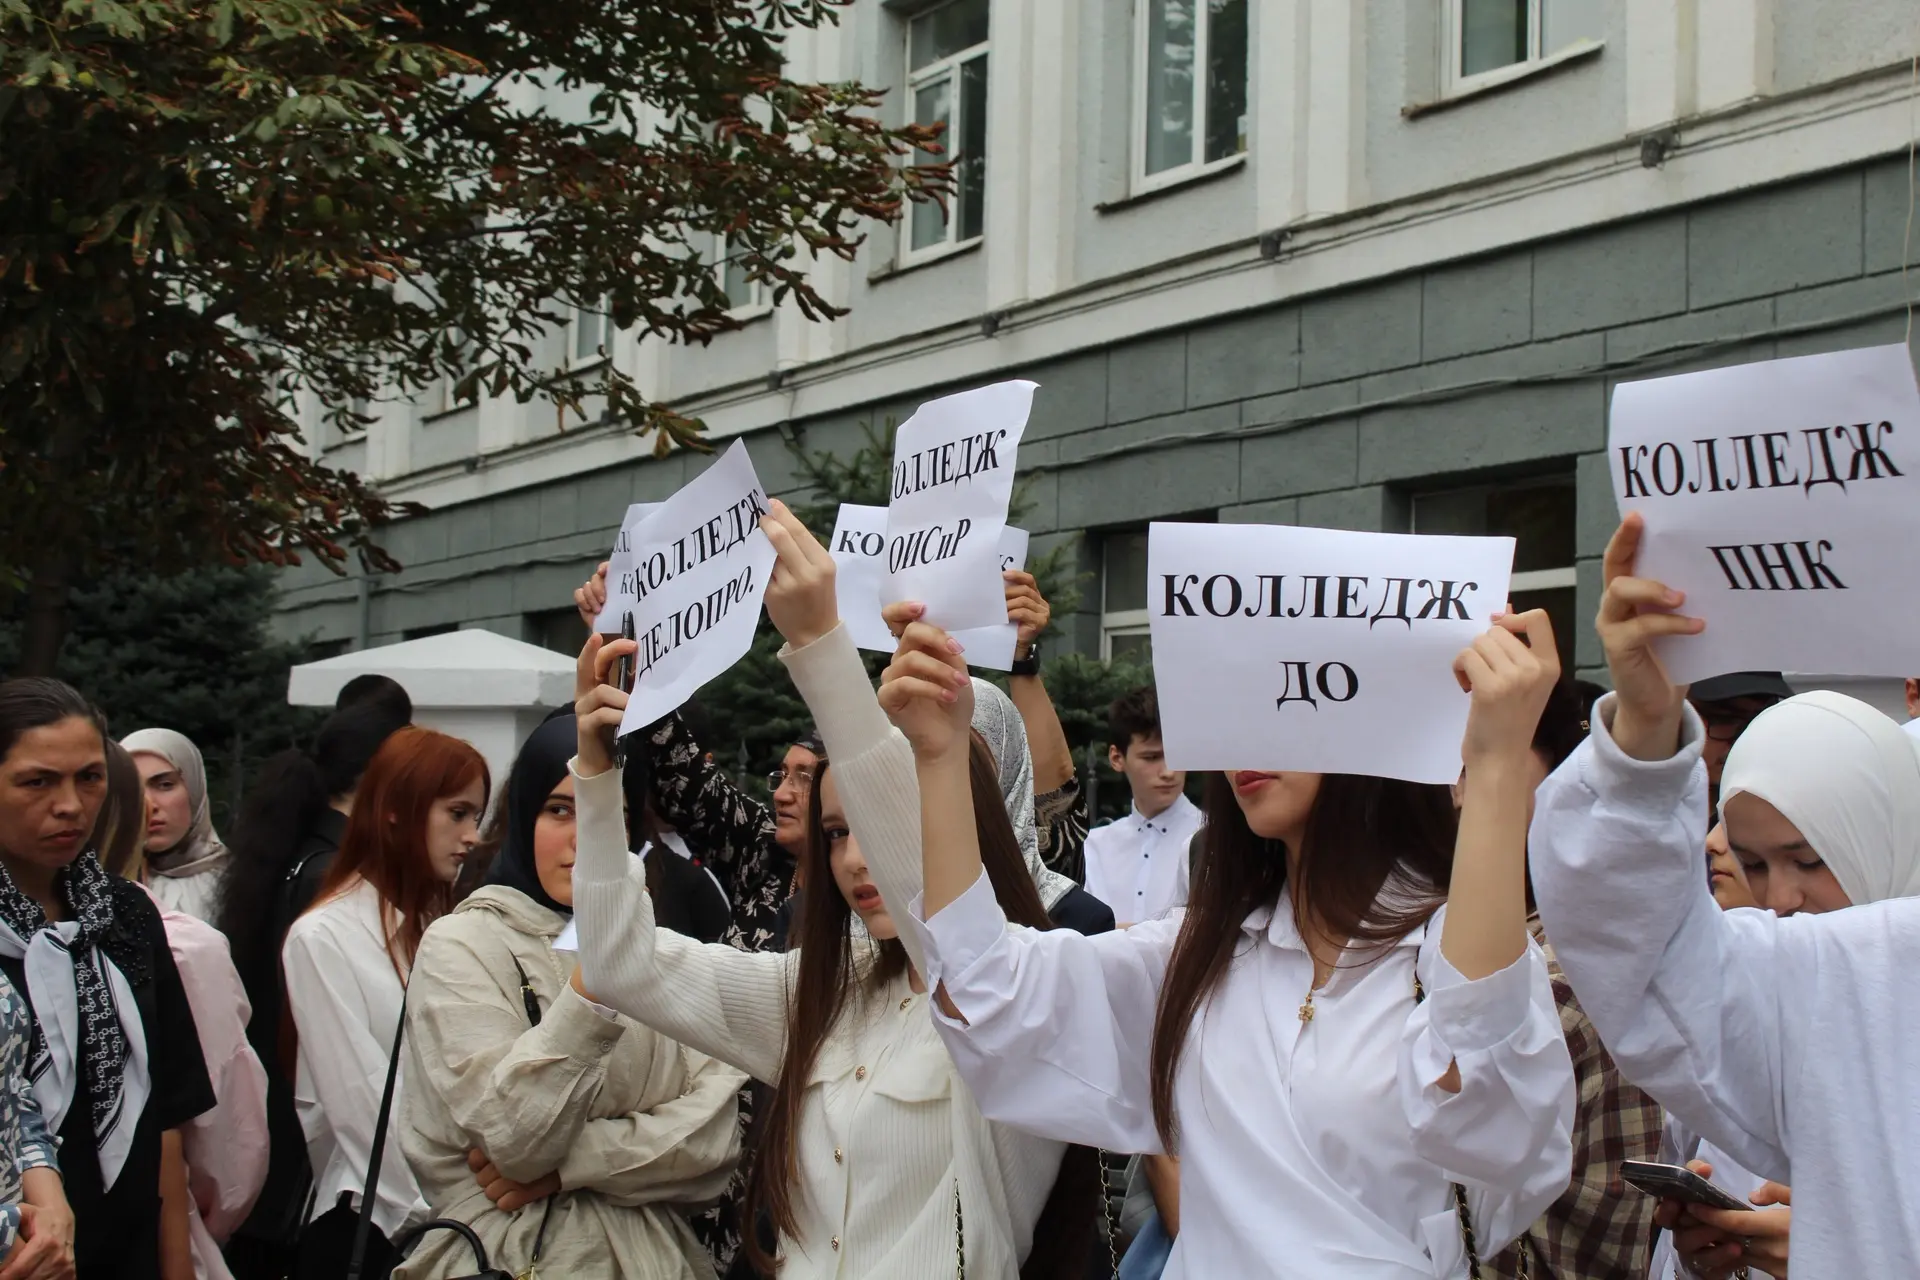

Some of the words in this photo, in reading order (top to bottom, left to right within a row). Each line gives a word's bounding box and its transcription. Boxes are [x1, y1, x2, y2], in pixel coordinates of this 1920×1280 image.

[891, 429, 1007, 502] ОЛЛЕДЖ
[1619, 420, 1905, 500] КОЛЛЕДЖ
[635, 486, 766, 604] КОЛЛЕДЖ
[889, 518, 971, 575] ОИСиР
[1706, 539, 1849, 591] ПНК
[638, 565, 754, 681] ДЕЛОПРО.
[1160, 574, 1479, 631] КОЛЛЕДЖ
[1276, 660, 1359, 712] ДО
